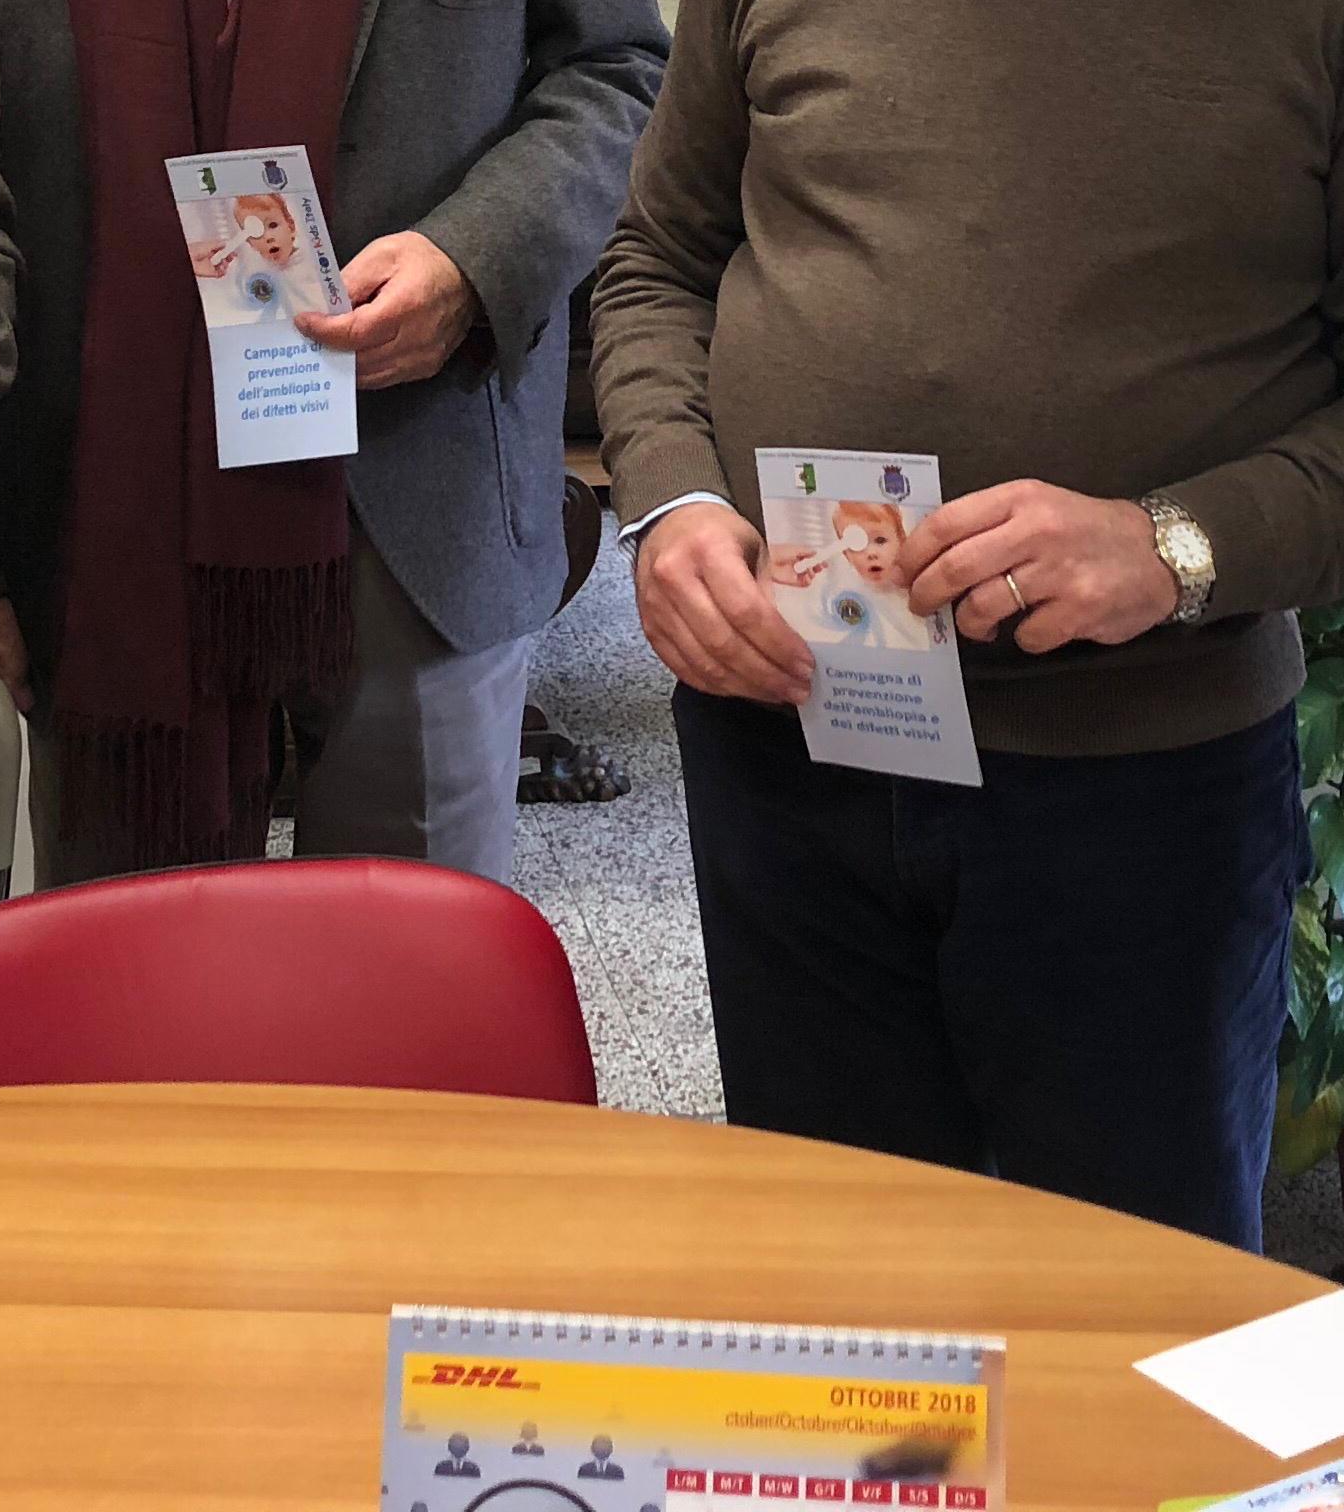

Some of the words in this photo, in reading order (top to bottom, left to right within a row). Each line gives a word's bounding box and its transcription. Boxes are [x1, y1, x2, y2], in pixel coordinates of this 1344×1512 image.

[244, 343, 307, 360] Campagna
[248, 362, 320, 382] prevenzione
[324, 380, 331, 390] e
[241, 408, 259, 420] dei
[263, 403, 297, 417] difetti
[300, 400, 329, 413] visivi
[825, 667, 903, 685] Campagna
[907, 674, 922, 686] di
[832, 686, 923, 704] prevenzione
[830, 718, 852, 730] dei
[930, 714, 940, 724] e
[431, 1364, 522, 1389] DHL
[830, 1386, 920, 1411] OTTOBRE
[927, 1392, 976, 1414] 2018
[674, 1474, 697, 1488] L/M
[720, 1476, 744, 1491] M/T
[764, 1479, 793, 1494] M/W
[814, 1483, 836, 1497] G/T
[862, 1486, 882, 1500] V/F
[909, 1489, 929, 1503] S/S
[954, 1491, 977, 1506] D/S
